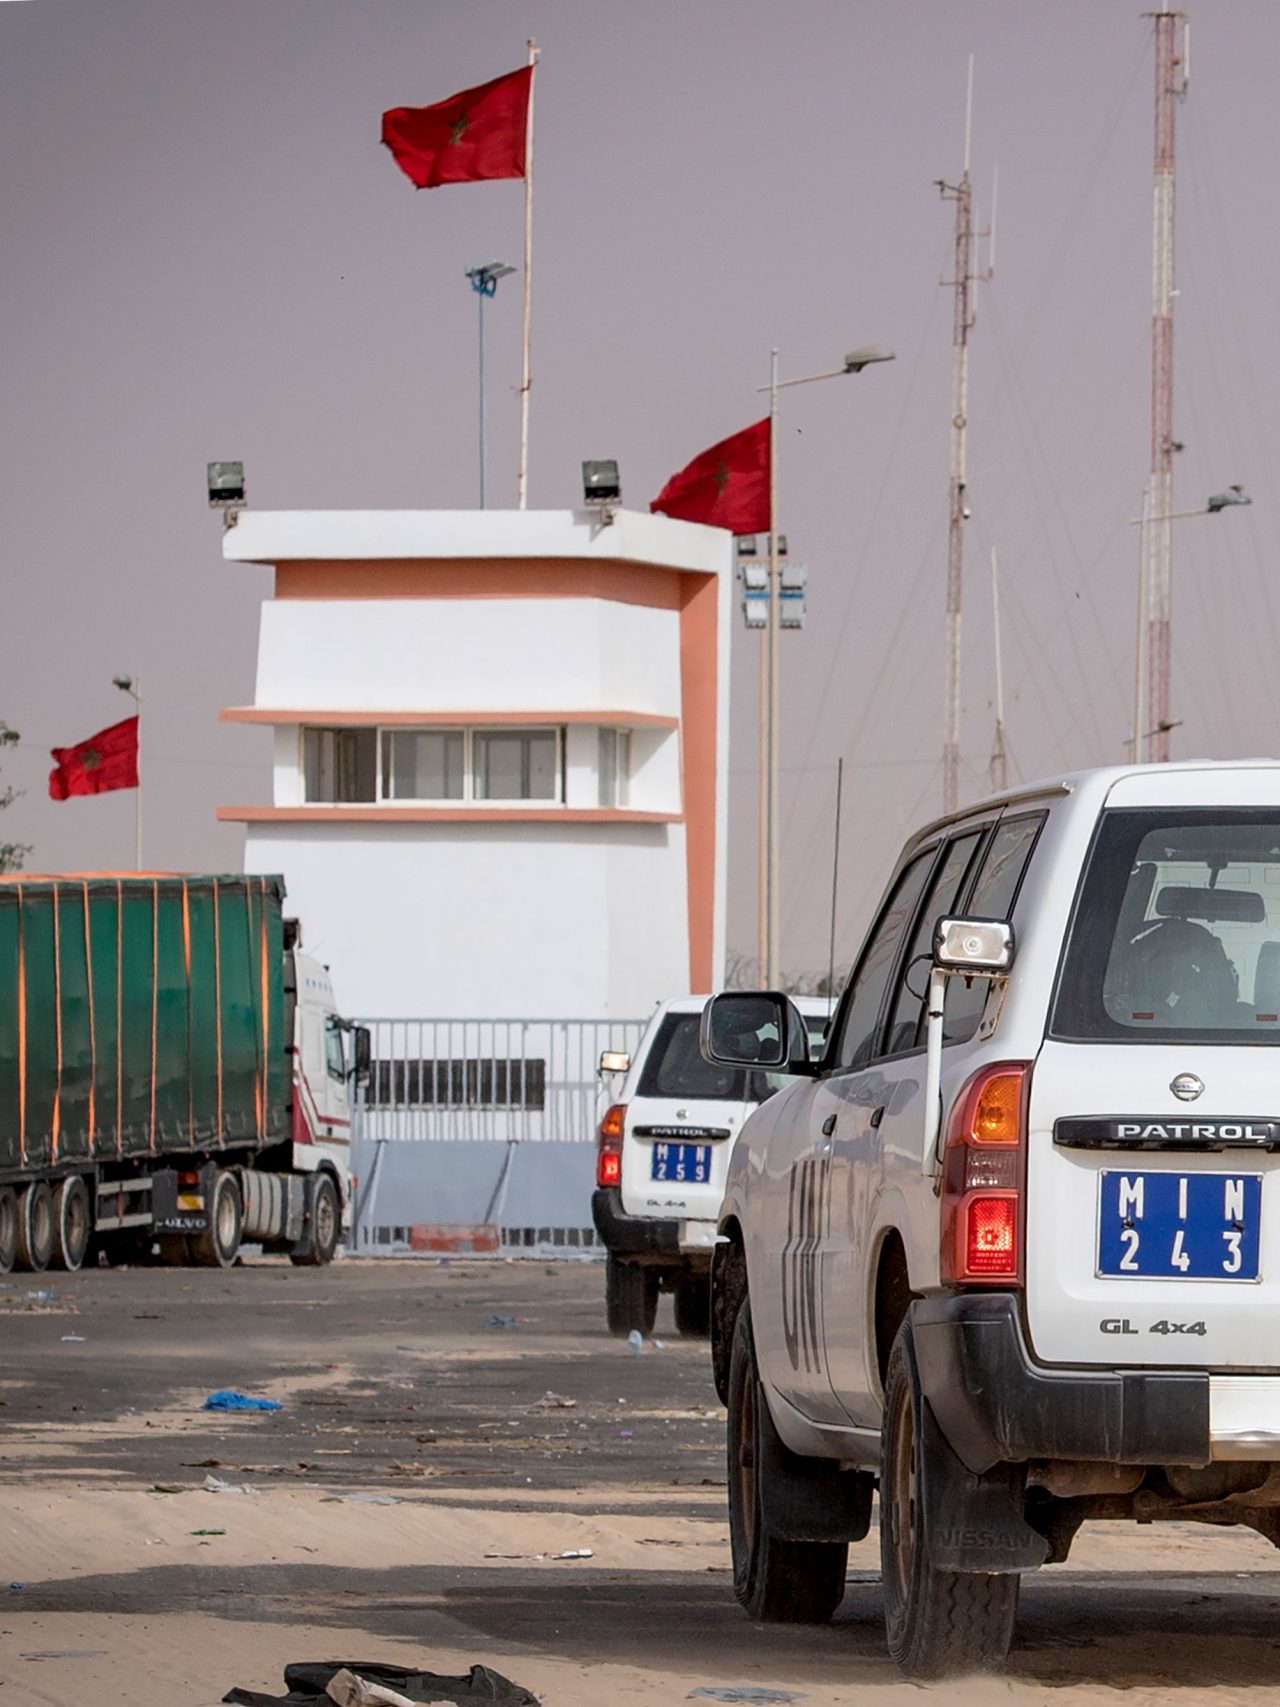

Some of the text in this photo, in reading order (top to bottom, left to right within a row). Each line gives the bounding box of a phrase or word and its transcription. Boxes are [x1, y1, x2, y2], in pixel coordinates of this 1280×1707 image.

[652, 1128, 707, 1137] PATROL
[1117, 1124, 1267, 1140] PATROL
[656, 1162, 705, 1181] 259
[1118, 1176, 1245, 1221] MIN
[1118, 1230, 1243, 1274] 243
[1099, 1319, 1208, 1337] GL 4x4
[936, 1528, 1035, 1551] NISSAN
